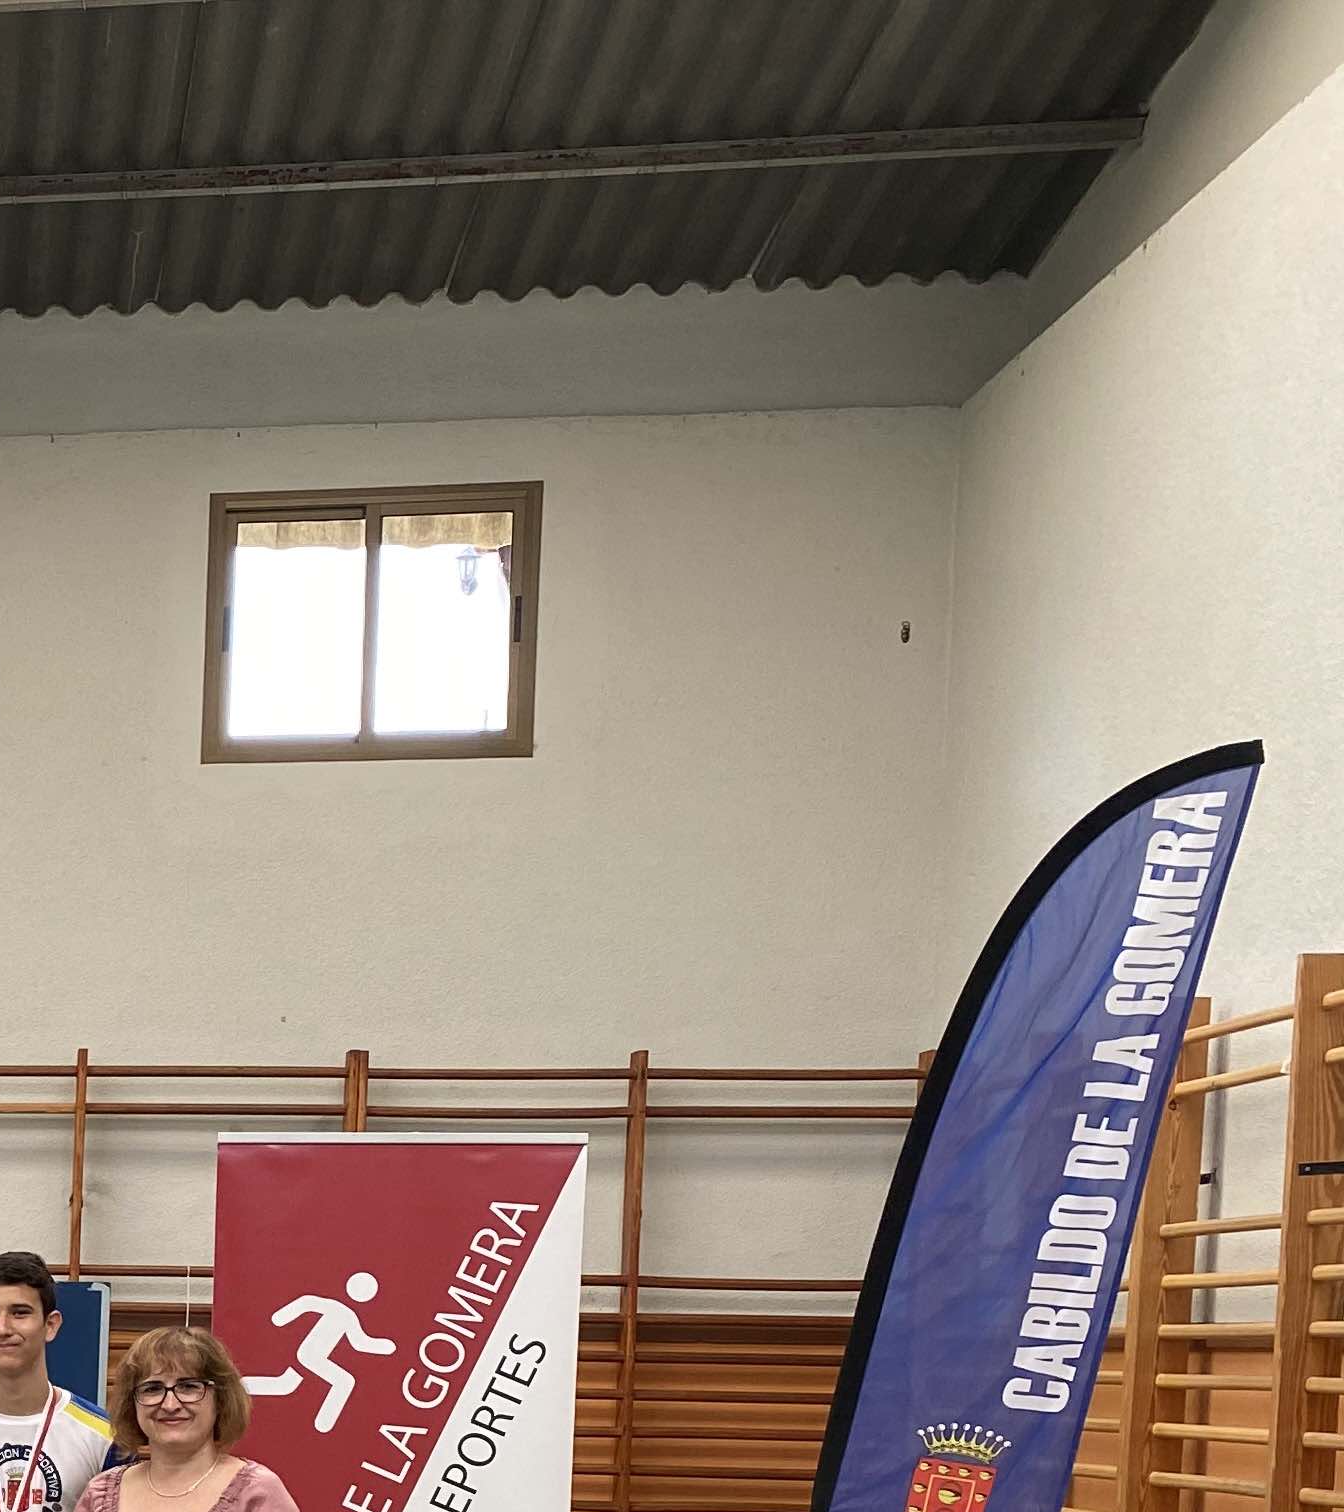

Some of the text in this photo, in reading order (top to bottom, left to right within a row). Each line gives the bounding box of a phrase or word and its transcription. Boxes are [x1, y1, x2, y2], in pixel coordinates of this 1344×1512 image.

[1002, 791, 1228, 1413] CABILDO DE LA GOMERA
[361, 1424, 428, 1484] LA
[402, 1201, 540, 1409] GOMERA
